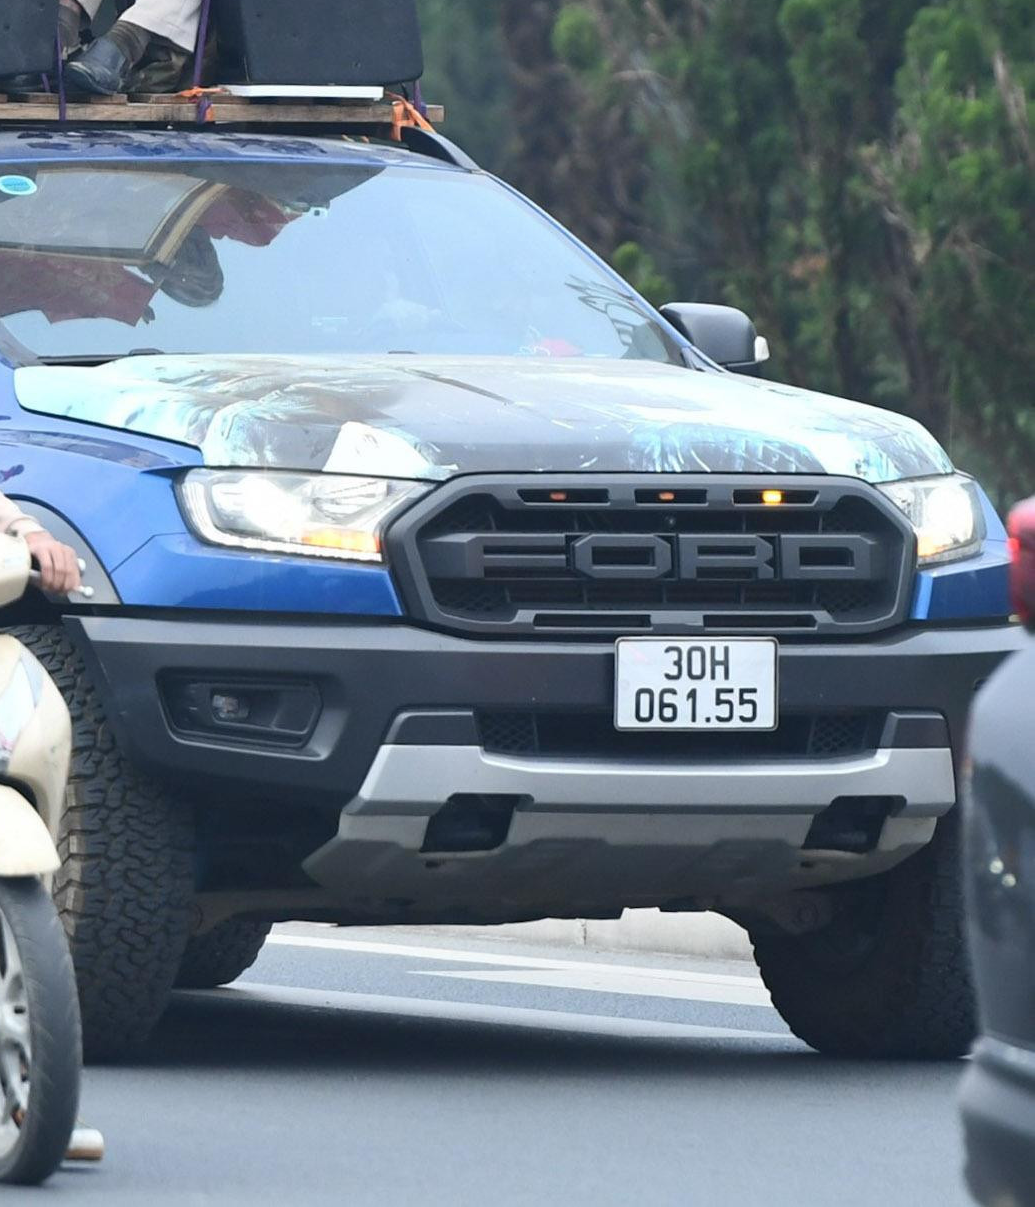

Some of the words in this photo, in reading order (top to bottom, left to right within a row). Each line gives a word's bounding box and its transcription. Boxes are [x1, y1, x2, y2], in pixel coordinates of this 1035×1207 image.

[461, 531, 875, 581] FORD
[664, 645, 730, 681] 30H
[634, 687, 758, 724] 061.55
